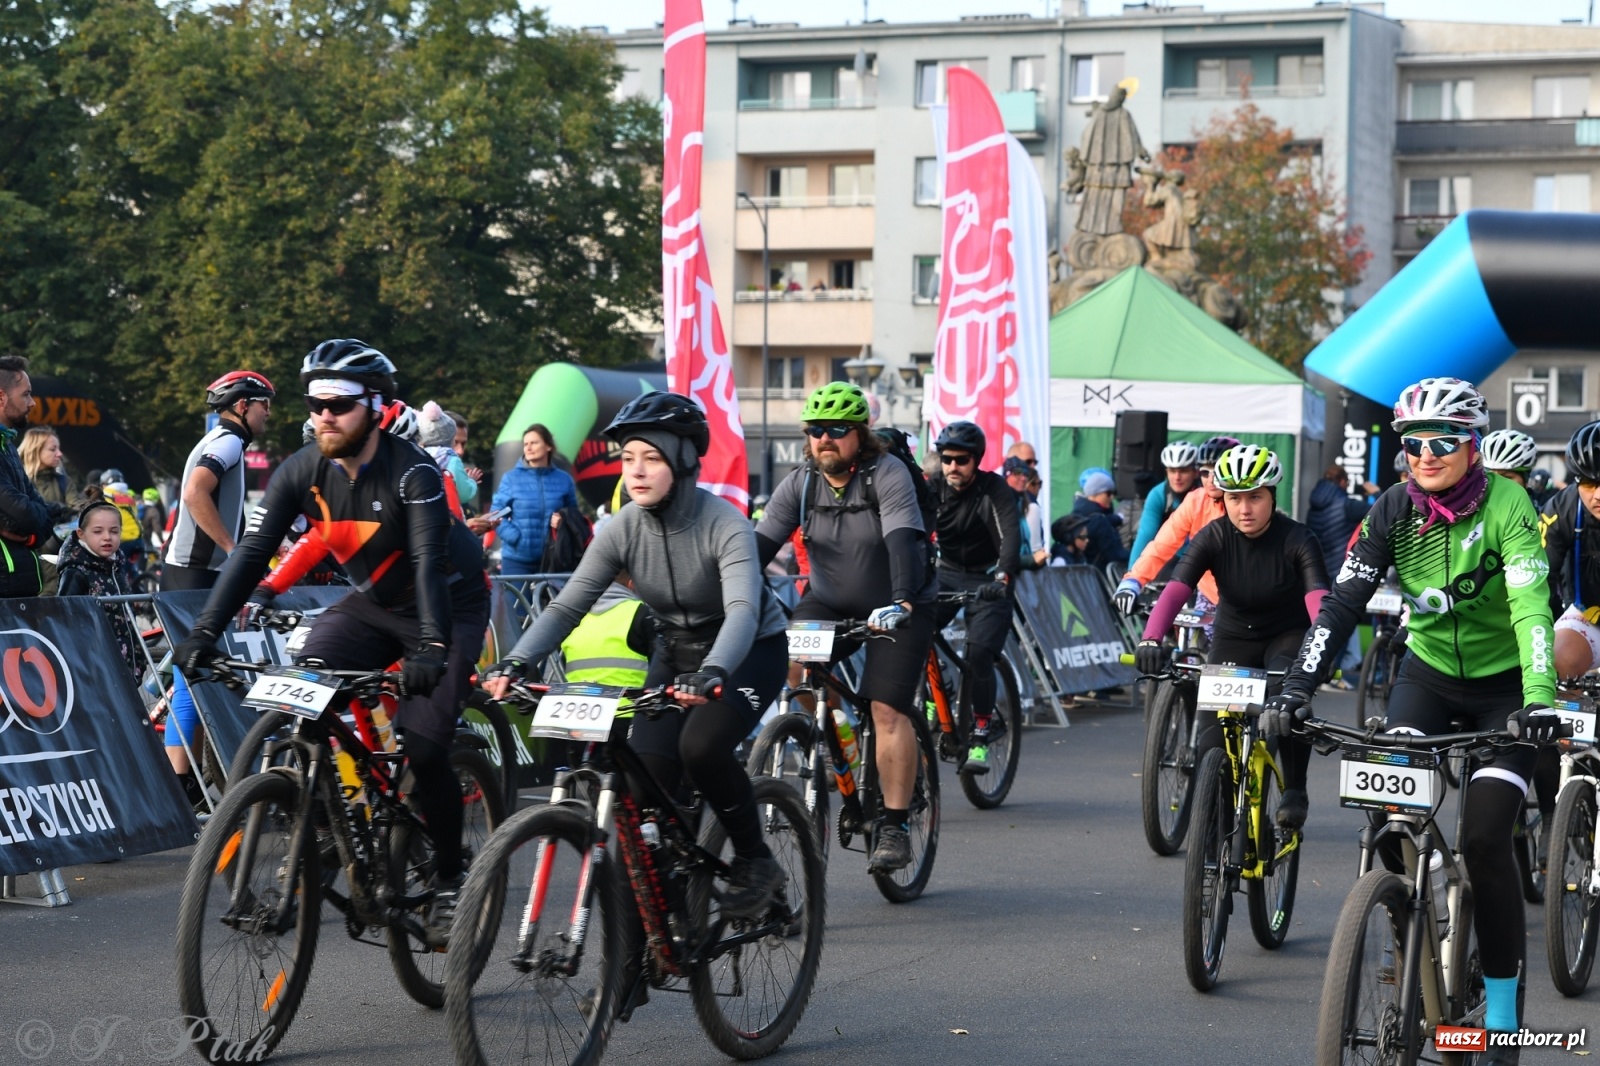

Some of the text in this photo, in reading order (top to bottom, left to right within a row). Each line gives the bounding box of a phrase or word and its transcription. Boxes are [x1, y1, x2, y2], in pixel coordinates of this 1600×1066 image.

[28, 396, 101, 427] AXXIS
[1516, 393, 1540, 426] 0
[264, 682, 318, 703] 1746
[1212, 682, 1255, 698] 3241
[550, 701, 603, 721] 2980
[1355, 771, 1416, 796] 3030
